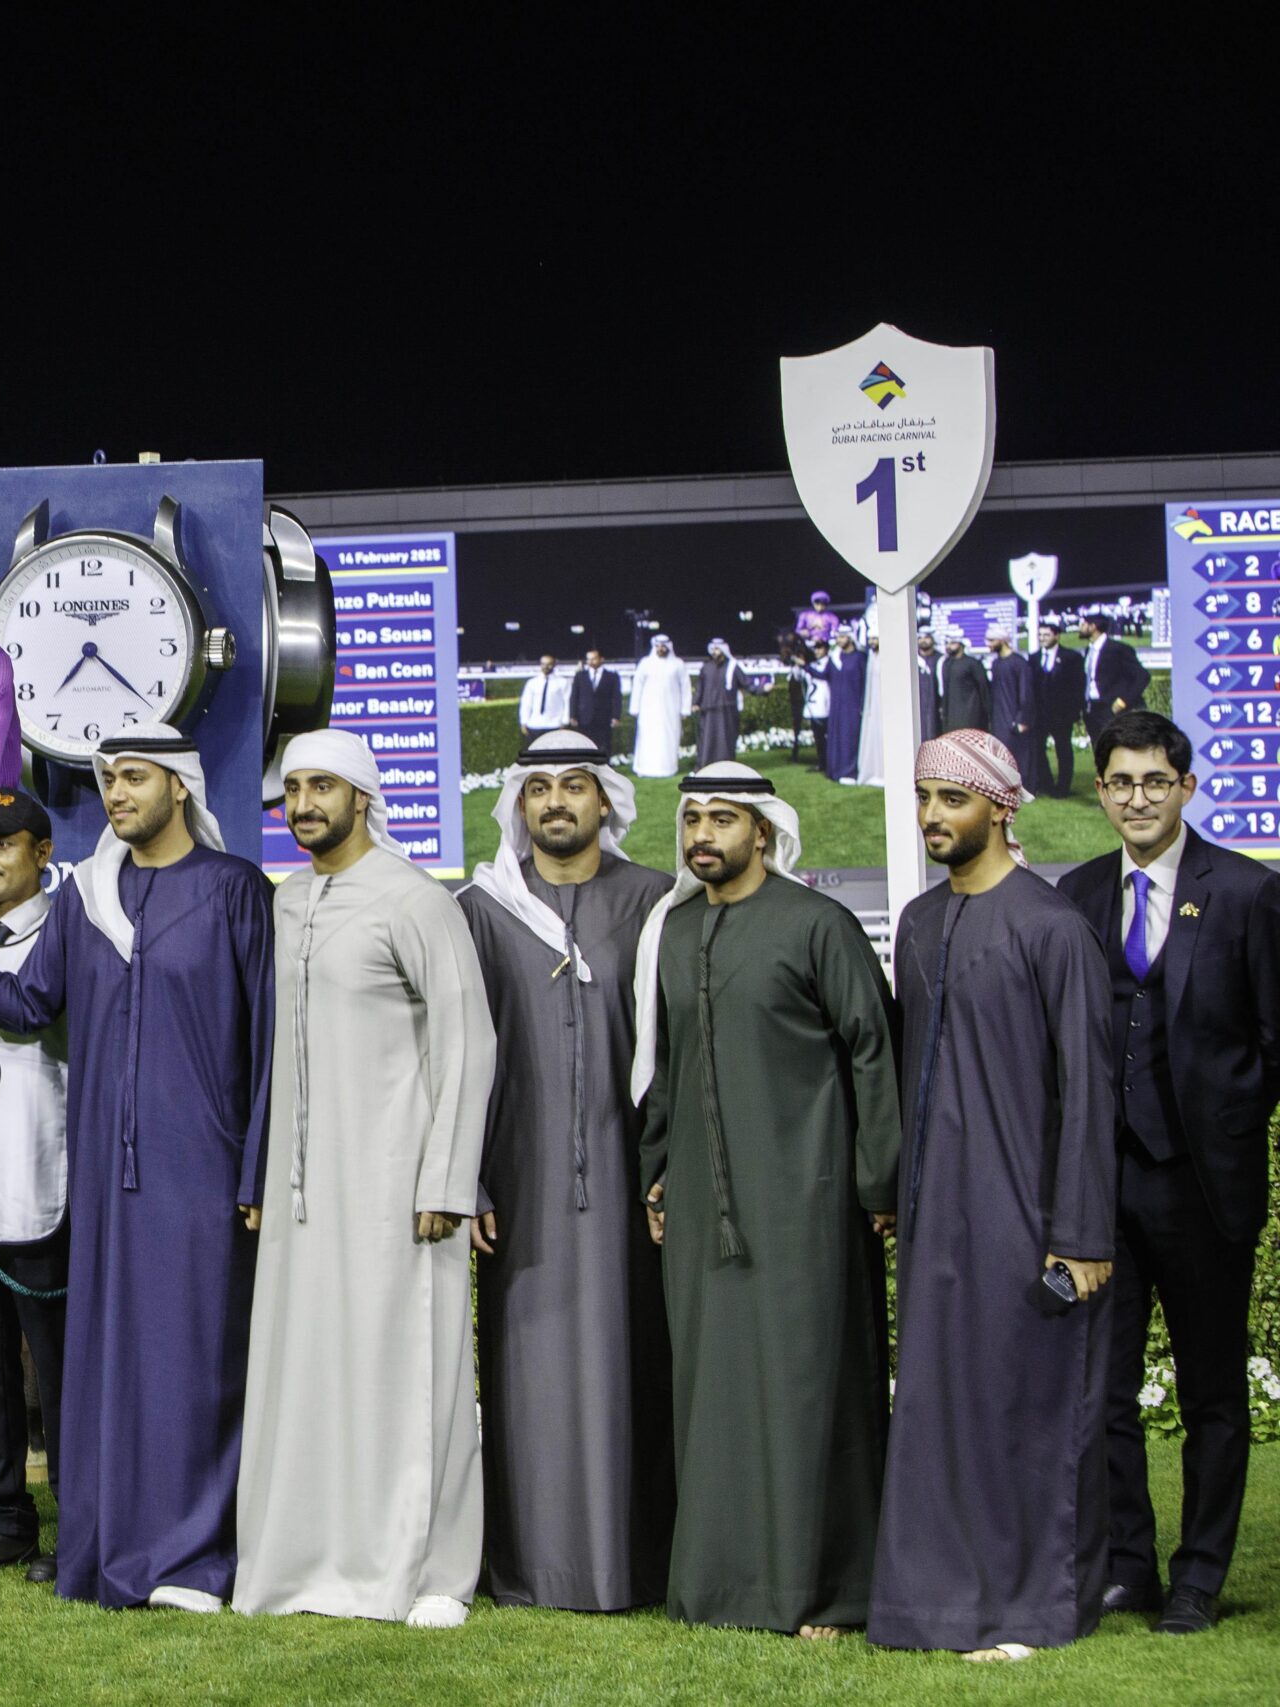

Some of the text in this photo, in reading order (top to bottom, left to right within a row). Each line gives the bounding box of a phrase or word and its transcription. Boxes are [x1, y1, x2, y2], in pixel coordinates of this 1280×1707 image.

[831, 416, 936, 434] كرنفال سباقات دبي
[831, 431, 937, 445] DUBAI RACING CARNIVAL
[1220, 510, 1280, 532] RACE
[339, 548, 441, 565] 14 February 2025
[1245, 555, 1260, 576] 2
[80, 559, 104, 576] 12
[46, 572, 60, 588] 11
[128, 570, 135, 586] 1
[53, 599, 130, 612] LONGINES
[149, 597, 166, 614] 2
[366, 590, 431, 609] Putzulu
[1246, 592, 1261, 613] 8
[19, 600, 41, 618] 10
[354, 628, 378, 645] De
[380, 626, 432, 643] Sousa
[1247, 628, 1262, 650] 6
[6, 642, 22, 660] 9
[159, 638, 178, 657] 3
[355, 662, 433, 679] Ben Coen
[1248, 665, 1263, 687] 7
[17, 683, 35, 701] 8
[147, 680, 166, 698] 4
[367, 697, 435, 715] Beasley
[1243, 702, 1272, 723] 12
[46, 713, 62, 731] 7
[122, 711, 139, 728] 5
[83, 723, 100, 741] 6
[372, 732, 435, 749] Balushi
[1250, 738, 1265, 760] 3
[1252, 775, 1267, 797] 5
[1246, 812, 1275, 833] 13
[817, 873, 840, 886] LG
